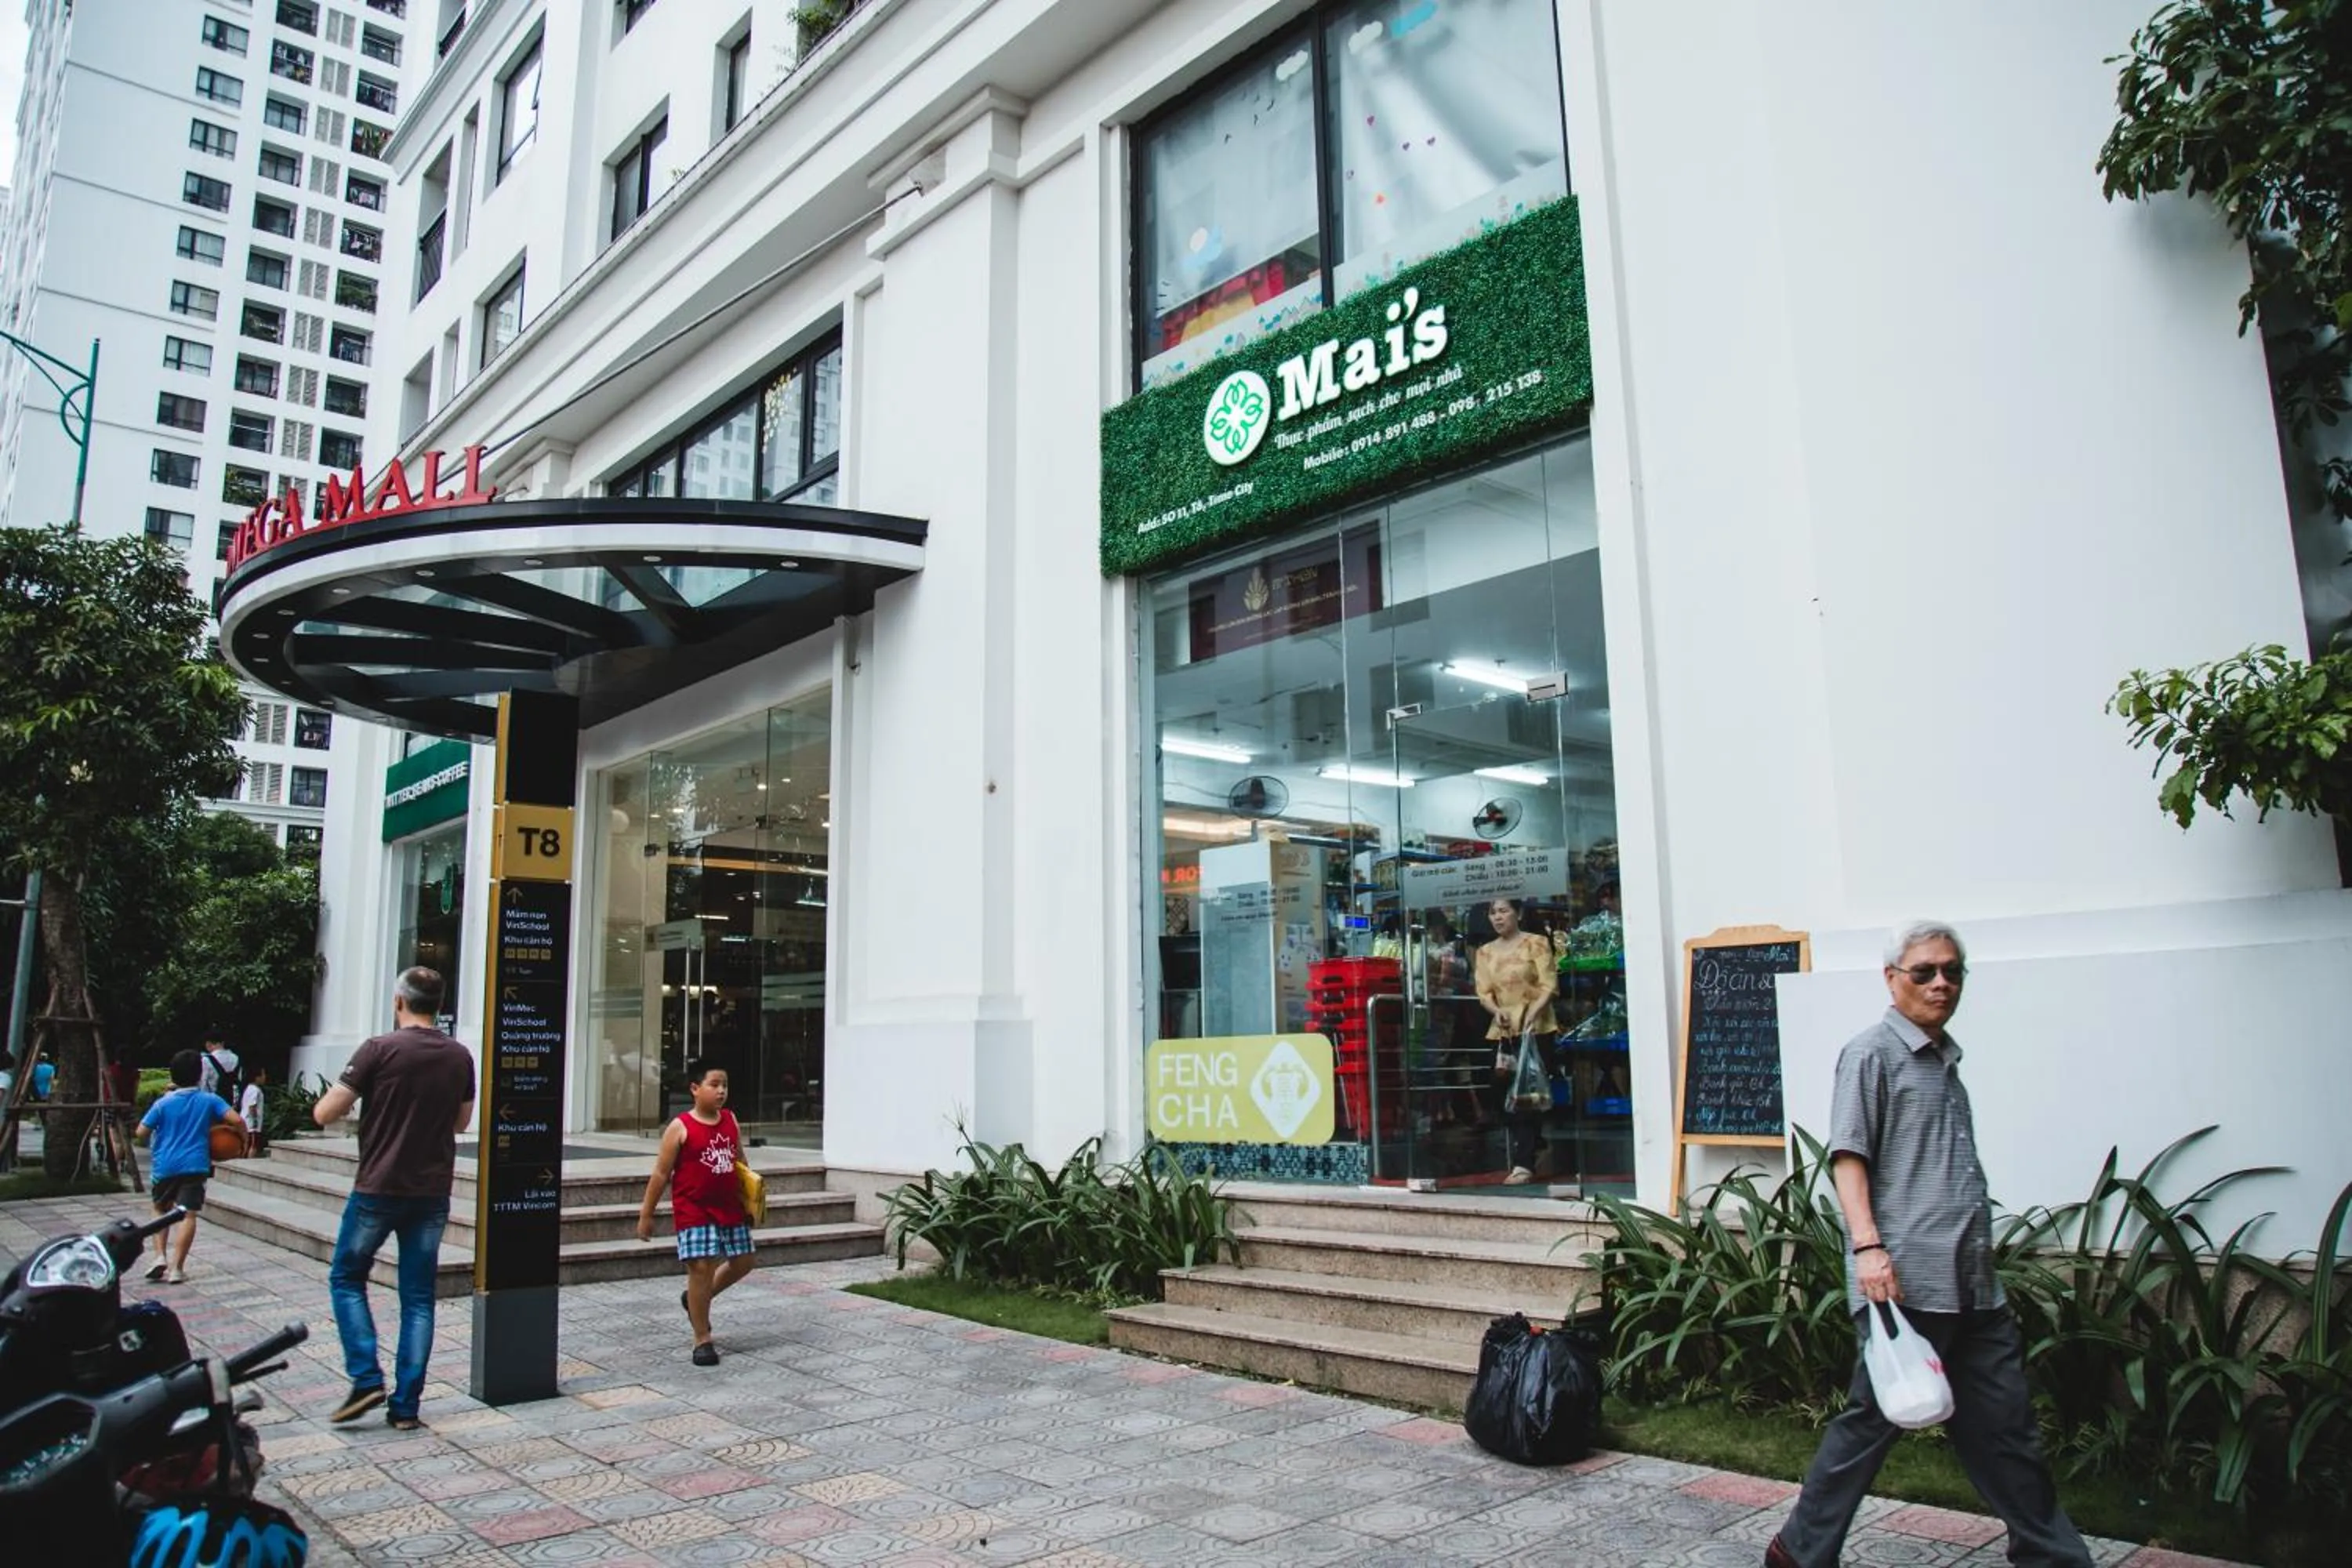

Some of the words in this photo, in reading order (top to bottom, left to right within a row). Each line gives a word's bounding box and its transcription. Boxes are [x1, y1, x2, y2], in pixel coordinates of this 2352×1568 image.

[1276, 288, 1448, 420] Mai's
[1378, 391, 1401, 411] cho
[1303, 447, 1348, 470] Mobile:
[1351, 431, 1381, 452] 0914
[1385, 421, 1408, 440] 891
[1410, 411, 1436, 429] 488
[1486, 382, 1513, 402] 215
[1517, 369, 1542, 390] 138
[320, 445, 498, 526] MALL
[1235, 481, 1254, 496] City
[517, 827, 560, 857] T8
[1157, 1051, 1240, 1088] FENG
[1157, 1093, 1240, 1129] CHA
